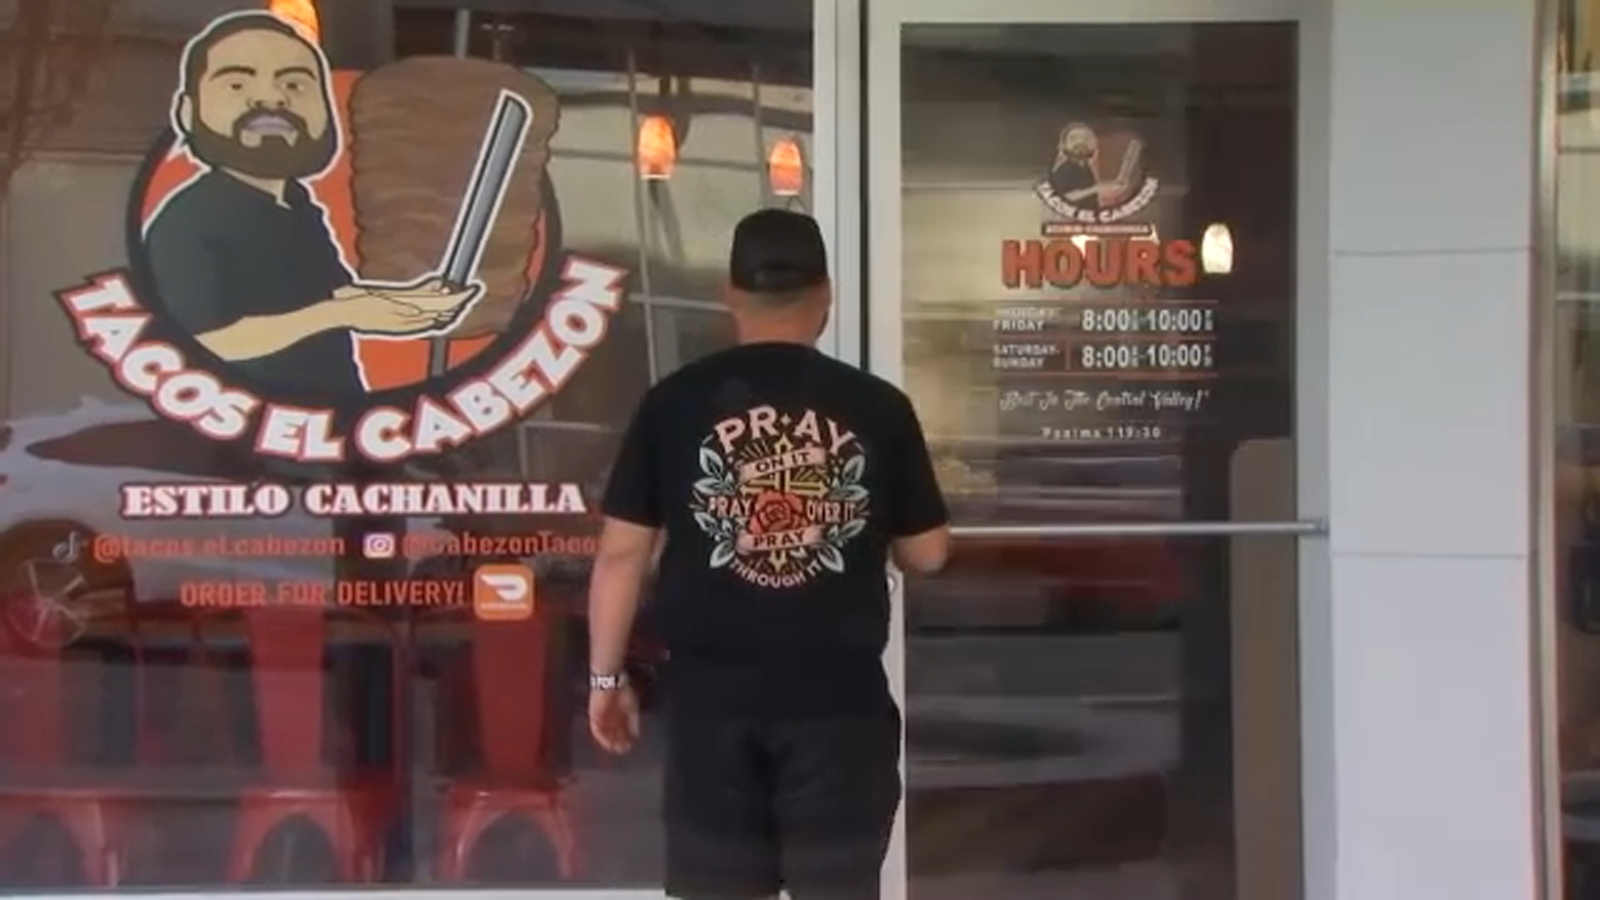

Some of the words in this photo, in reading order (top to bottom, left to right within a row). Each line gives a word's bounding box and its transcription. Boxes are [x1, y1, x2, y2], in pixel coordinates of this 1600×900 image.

[1001, 239, 1198, 288] HOURS
[62, 274, 257, 440] TACOS
[257, 403, 345, 461] EL
[355, 255, 630, 461] CABEZON
[756, 457, 784, 473] ON
[791, 452, 811, 464] IT
[122, 484, 290, 515] ESTILO
[305, 484, 587, 515] CACHANILLA
[707, 497, 752, 518] PRAY
[806, 502, 841, 522] OVER
[844, 504, 856, 521] IT
[754, 531, 806, 547] PRAY
[729, 559, 807, 588] THROUGH
[807, 560, 822, 577] IT
[180, 582, 267, 607] ORDER
[277, 582, 326, 606] FOR
[338, 581, 465, 606] DELIVERY!
